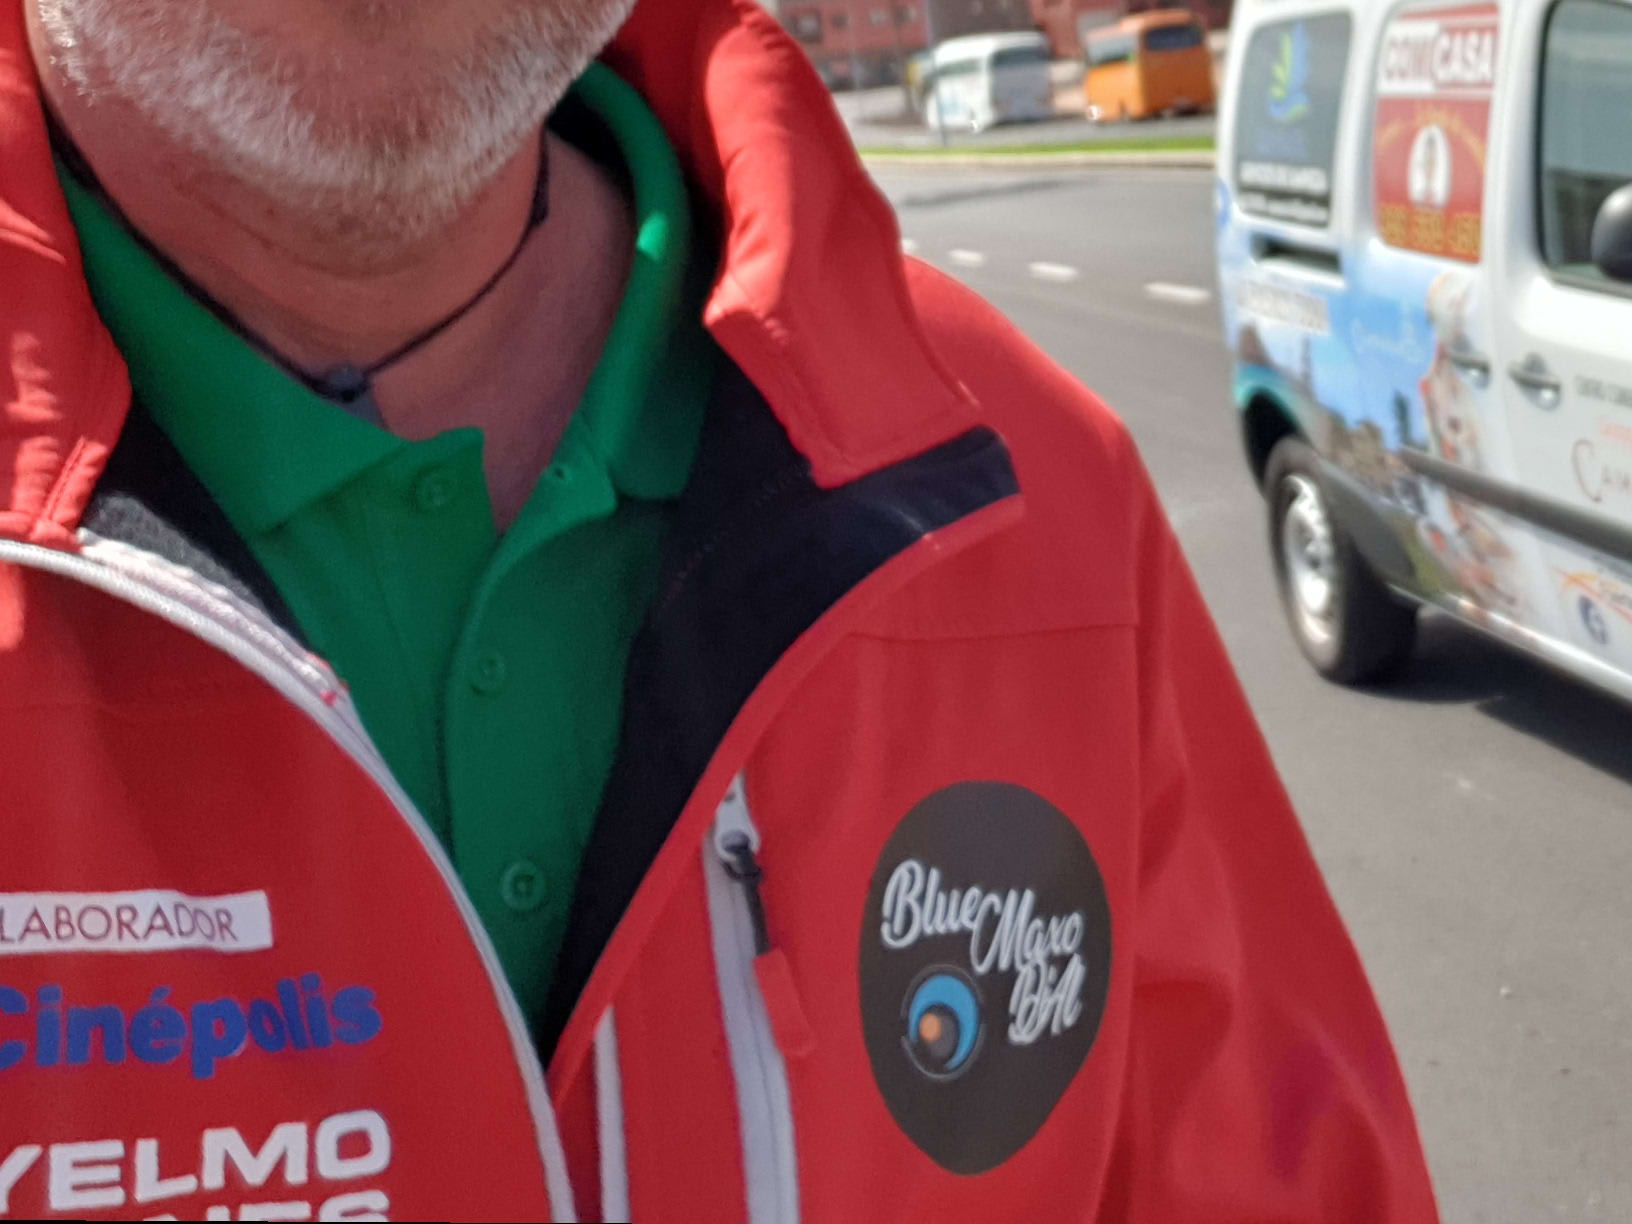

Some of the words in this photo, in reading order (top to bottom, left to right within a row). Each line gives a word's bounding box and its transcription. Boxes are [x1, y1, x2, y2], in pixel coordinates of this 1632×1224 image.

[0, 902, 239, 943] LABORADOR
[881, 858, 979, 949] Blue
[0, 1108, 392, 1214] YELMO
